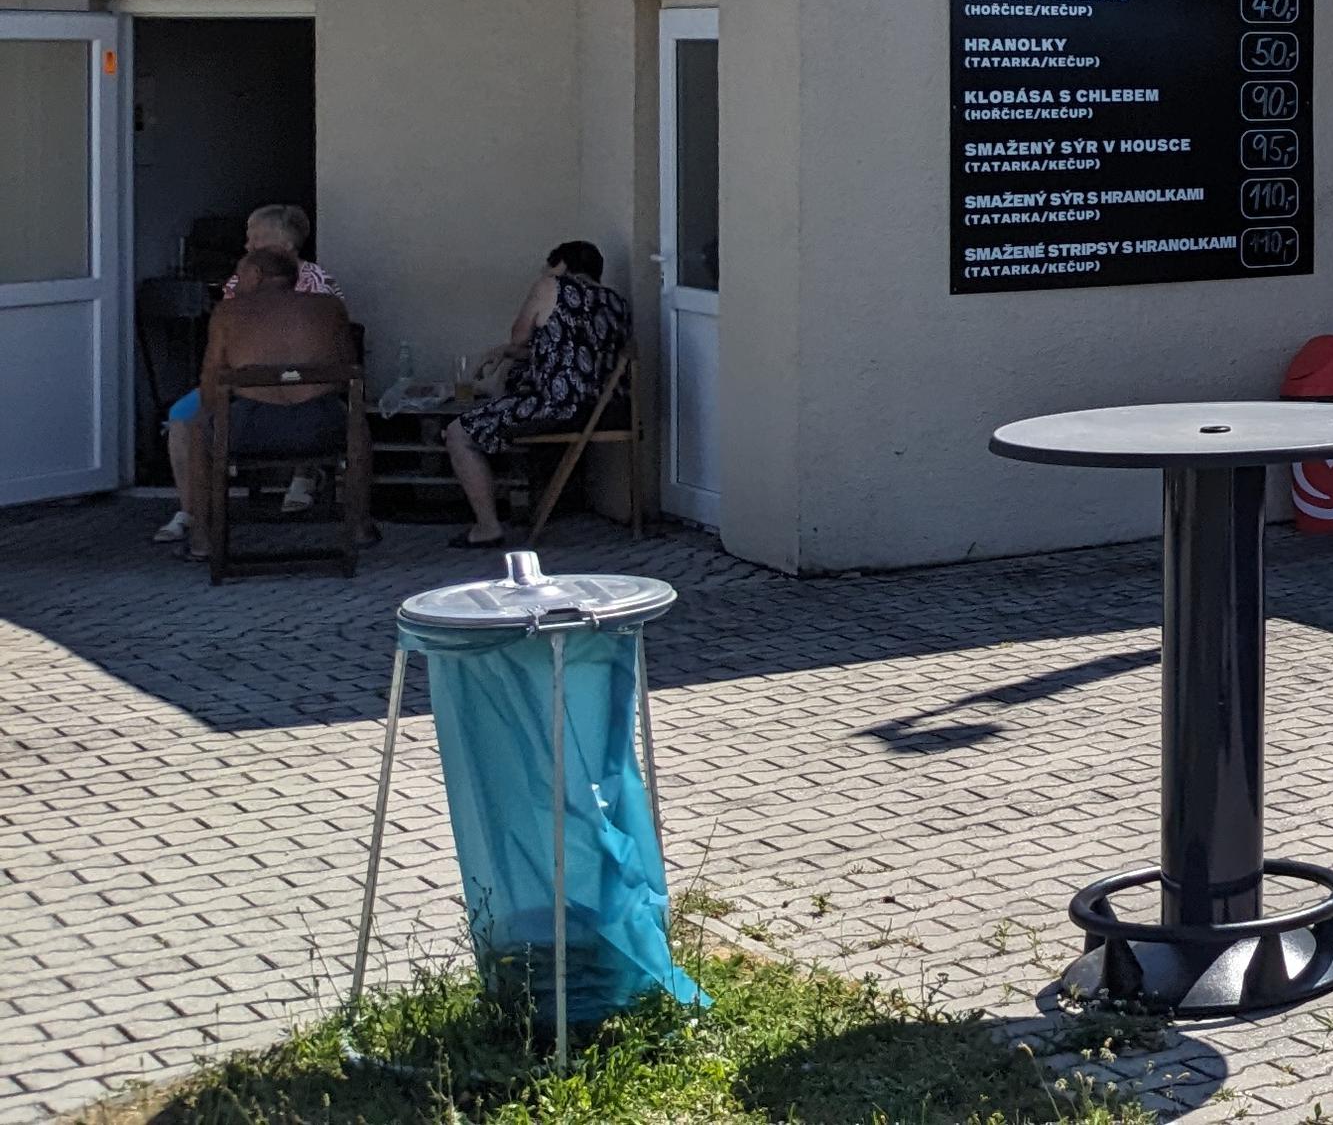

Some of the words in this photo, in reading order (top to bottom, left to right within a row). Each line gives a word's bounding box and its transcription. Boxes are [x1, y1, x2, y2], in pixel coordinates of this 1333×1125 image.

[964, 38, 1067, 52] HRANOLKY
[964, 55, 1100, 69] (TATARKA/KEČUP)
[964, 87, 1055, 104] KLOBÁSA
[1059, 89, 1071, 103] S
[1076, 88, 1159, 103] CHLEBEM
[964, 138, 1056, 157] SMAŽENÝ
[1060, 138, 1098, 155] SÝR
[1102, 140, 1116, 153] V
[1120, 138, 1192, 153] HOUSCE
[964, 157, 1101, 174] (TATARKA/KEČUP)
[964, 190, 1047, 209] SMAŽENÝ
[1049, 189, 1085, 206] SÝR
[1086, 191, 1099, 205] S
[1100, 187, 1204, 204] HRANOLKAMI
[964, 208, 1101, 226] (TATARKA/KEČUP)
[964, 242, 1046, 262] SMAŽENÉ
[1047, 241, 1120, 258] STRIPSY
[1121, 240, 1134, 254] S
[1135, 235, 1237, 254] HRANOLKAMI
[964, 259, 1101, 279] (TATARKA/KEČUP)
